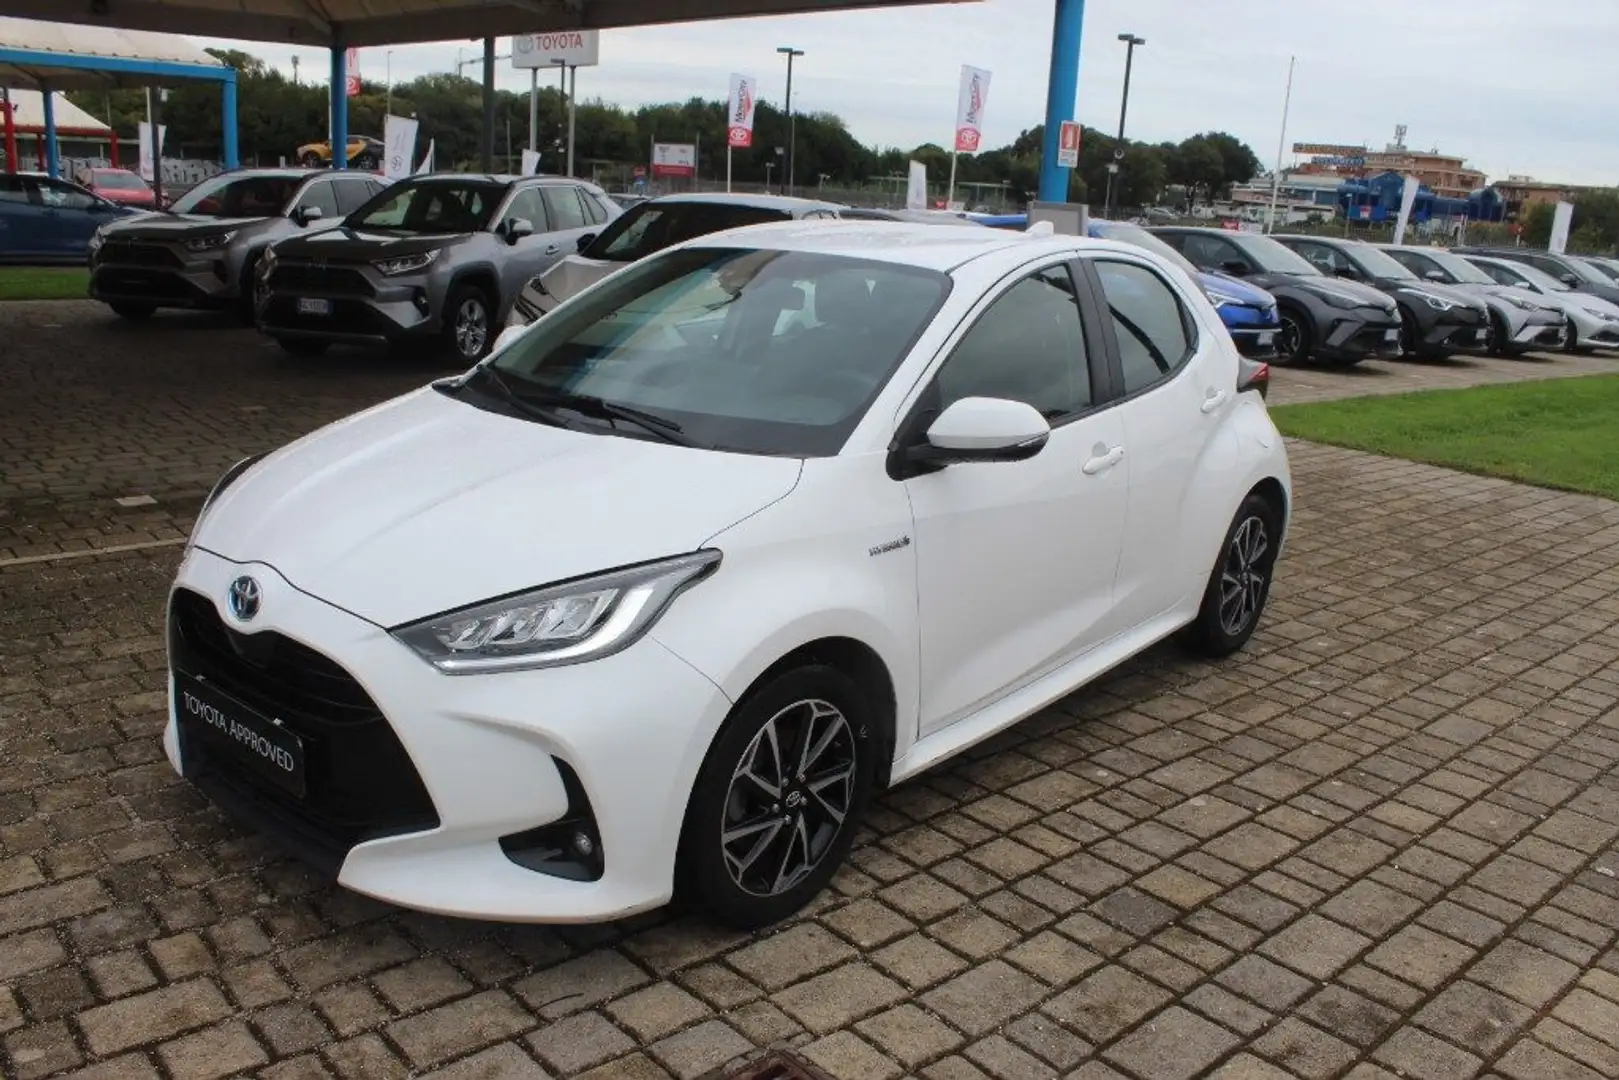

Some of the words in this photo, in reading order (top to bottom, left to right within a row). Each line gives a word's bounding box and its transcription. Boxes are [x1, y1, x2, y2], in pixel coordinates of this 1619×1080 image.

[536, 33, 584, 50] TOYOTA
[184, 691, 228, 732] TOYOTA
[229, 719, 294, 771] APPROVED
